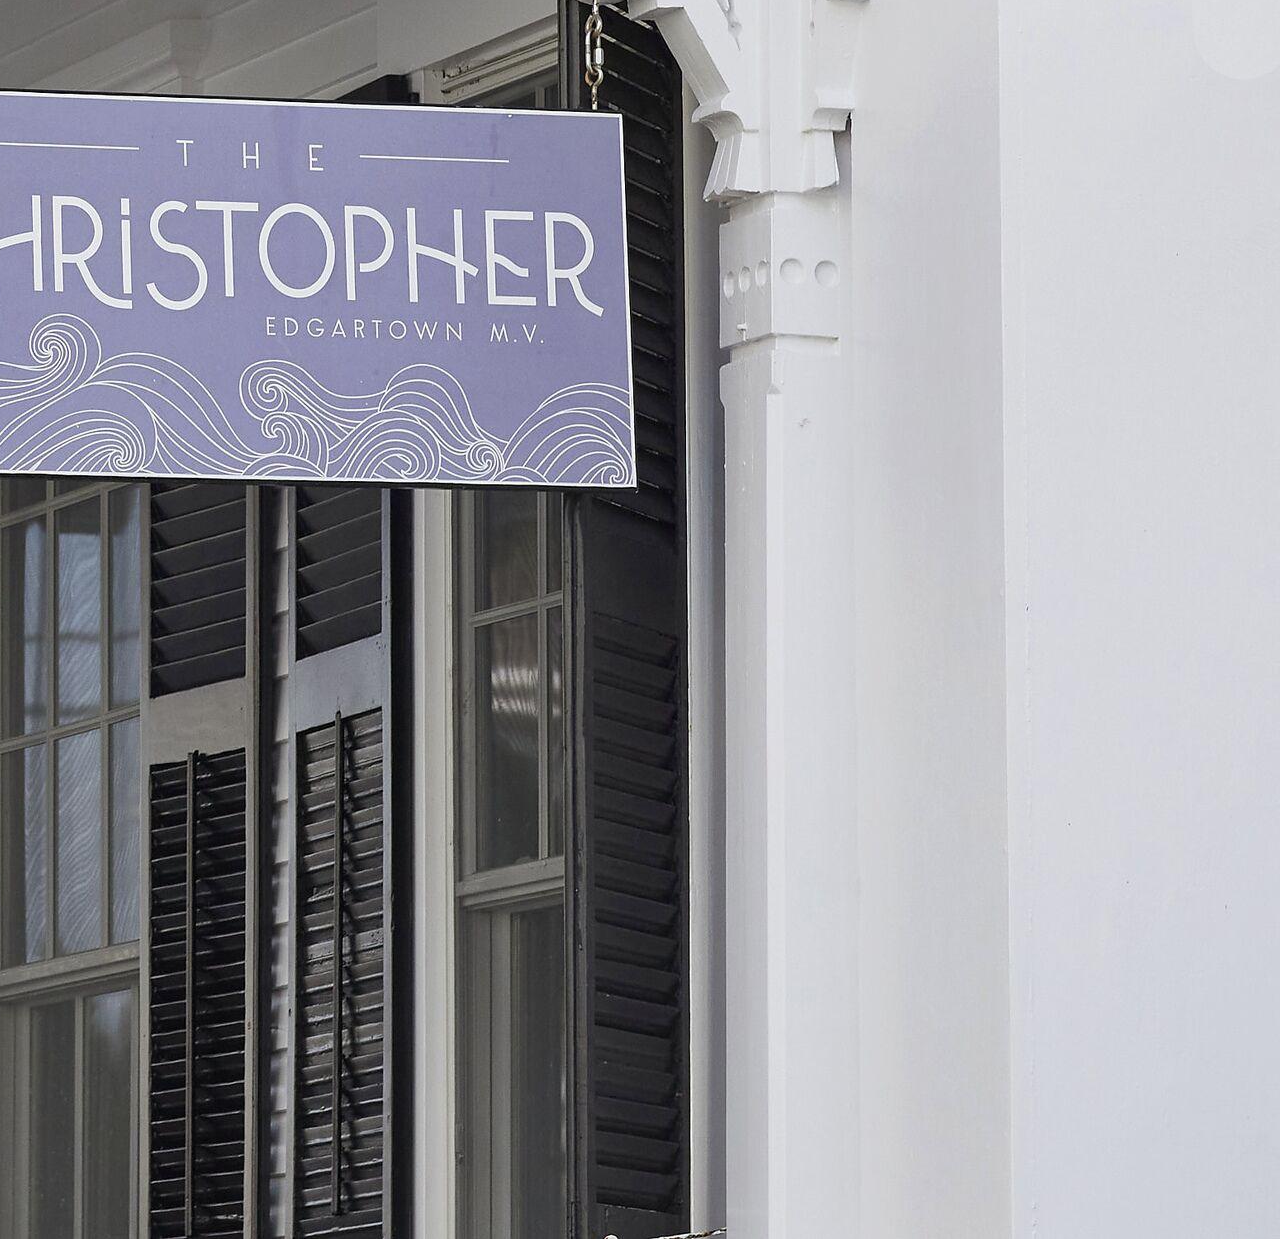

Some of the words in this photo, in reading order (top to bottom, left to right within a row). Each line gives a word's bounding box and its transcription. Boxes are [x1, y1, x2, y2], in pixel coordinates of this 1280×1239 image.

[175, 139, 324, 172] THE
[265, 316, 463, 341] EDGARTOWN
[489, 322, 545, 344] M.V.
